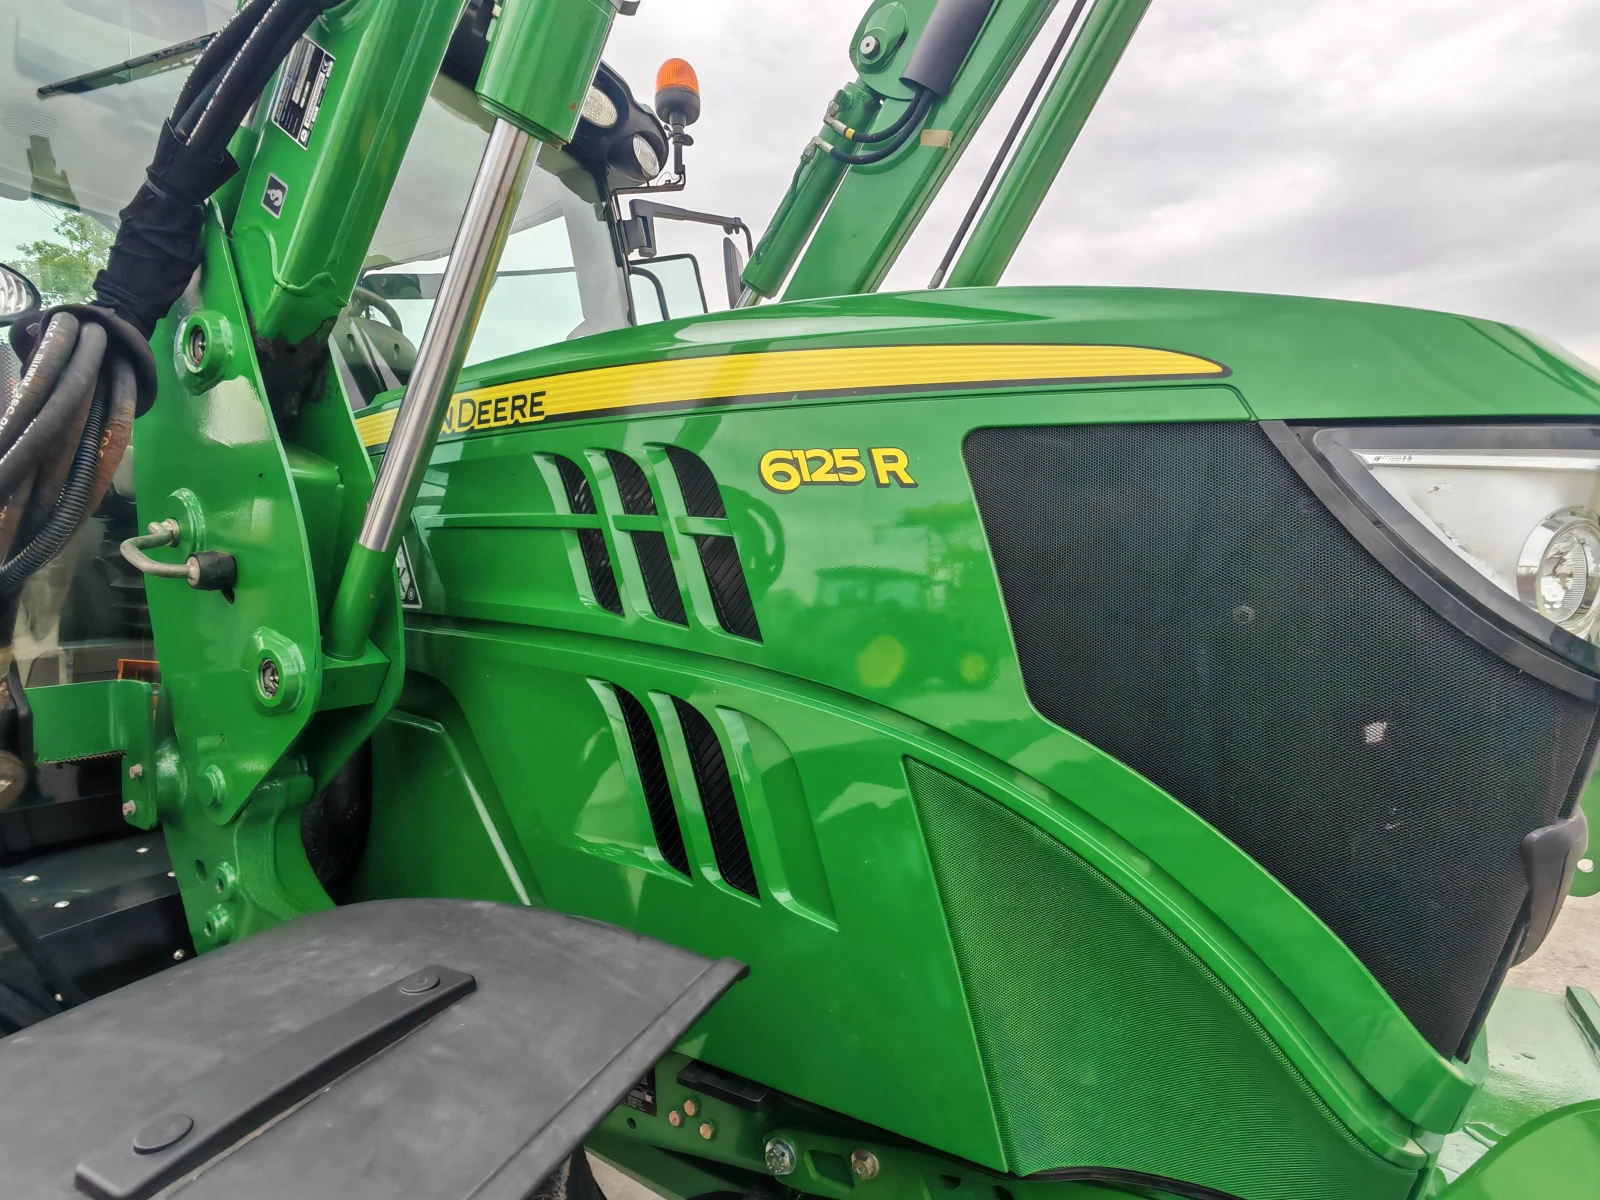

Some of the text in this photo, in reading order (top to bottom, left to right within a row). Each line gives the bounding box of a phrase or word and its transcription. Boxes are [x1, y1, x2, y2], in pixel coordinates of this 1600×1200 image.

[457, 390, 547, 429] DEERE
[758, 447, 918, 494] 6125 R
